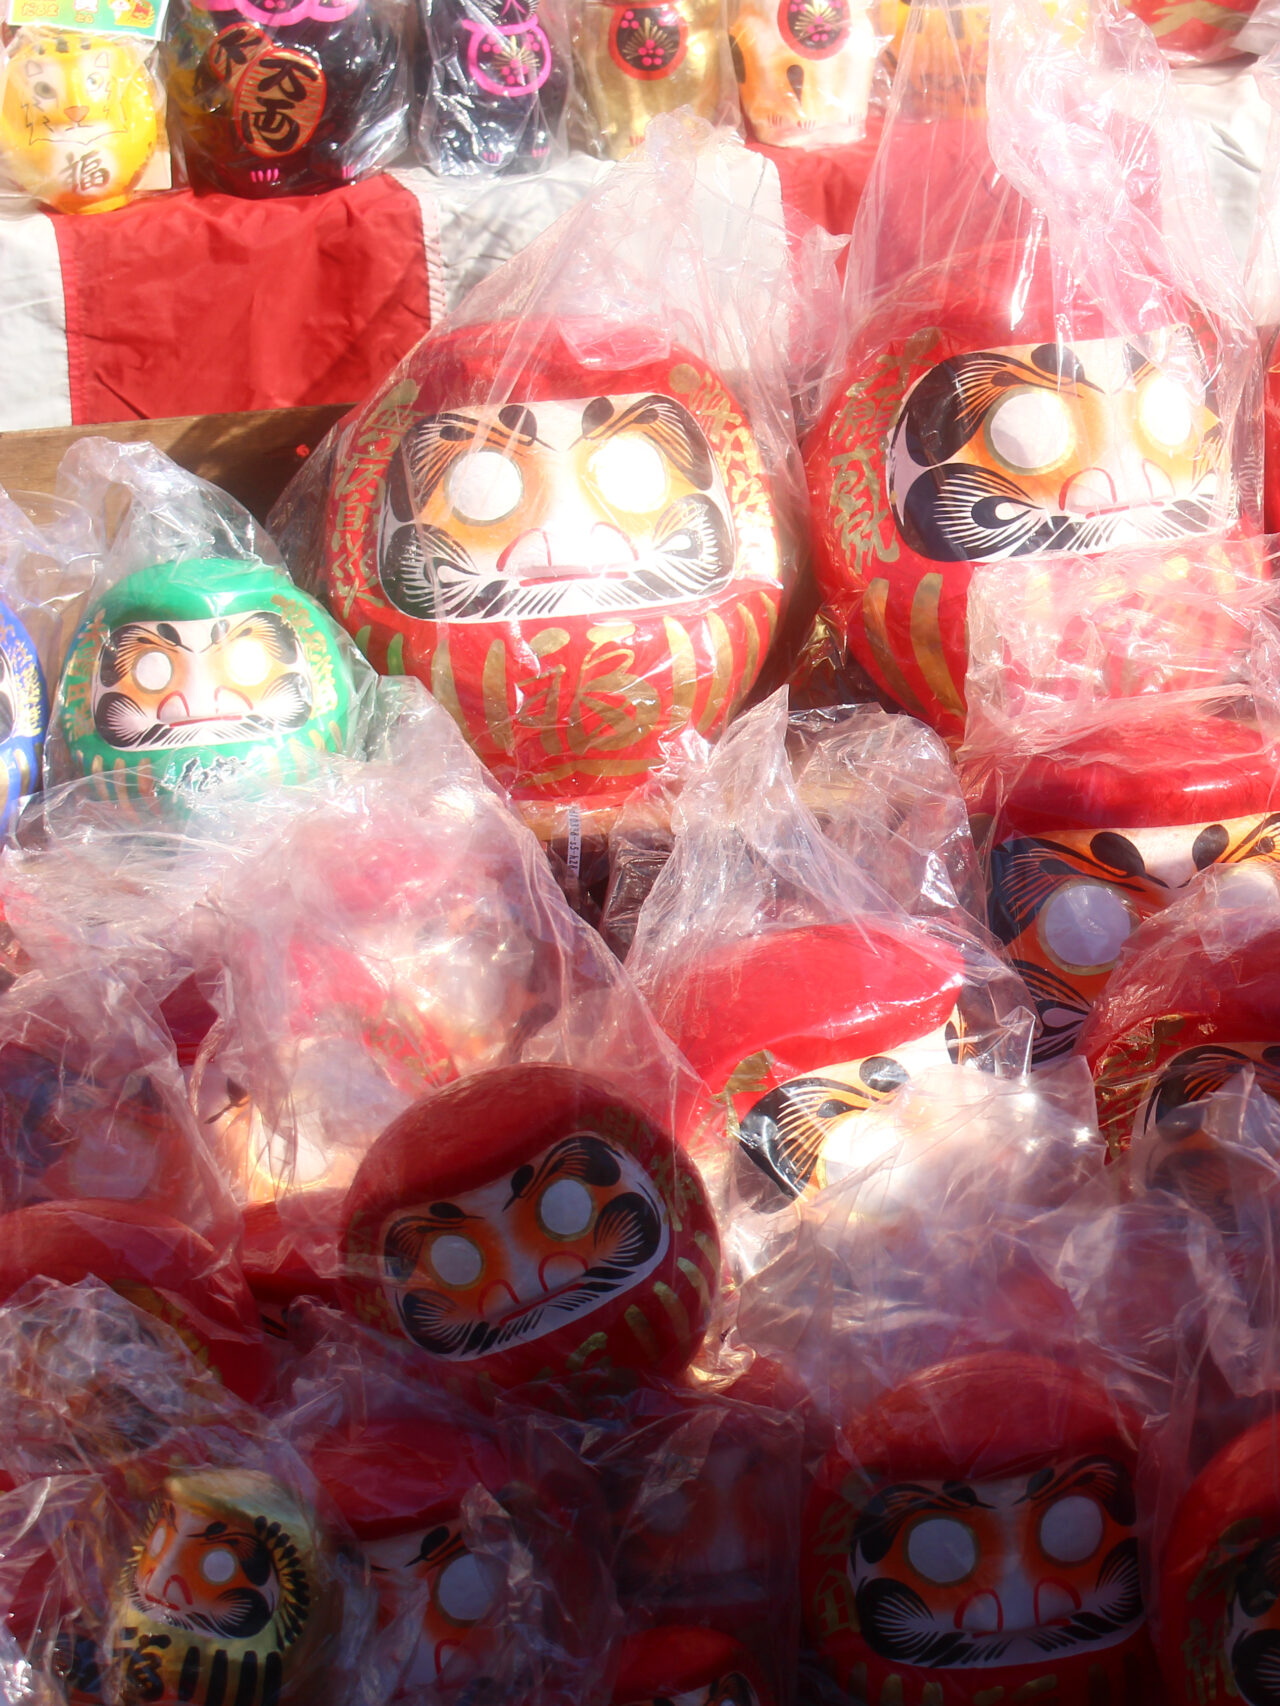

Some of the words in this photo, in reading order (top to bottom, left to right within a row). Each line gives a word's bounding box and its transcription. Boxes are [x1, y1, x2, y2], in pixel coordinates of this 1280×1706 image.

[58, 149, 111, 193] 福
[828, 325, 942, 576] 大願成就
